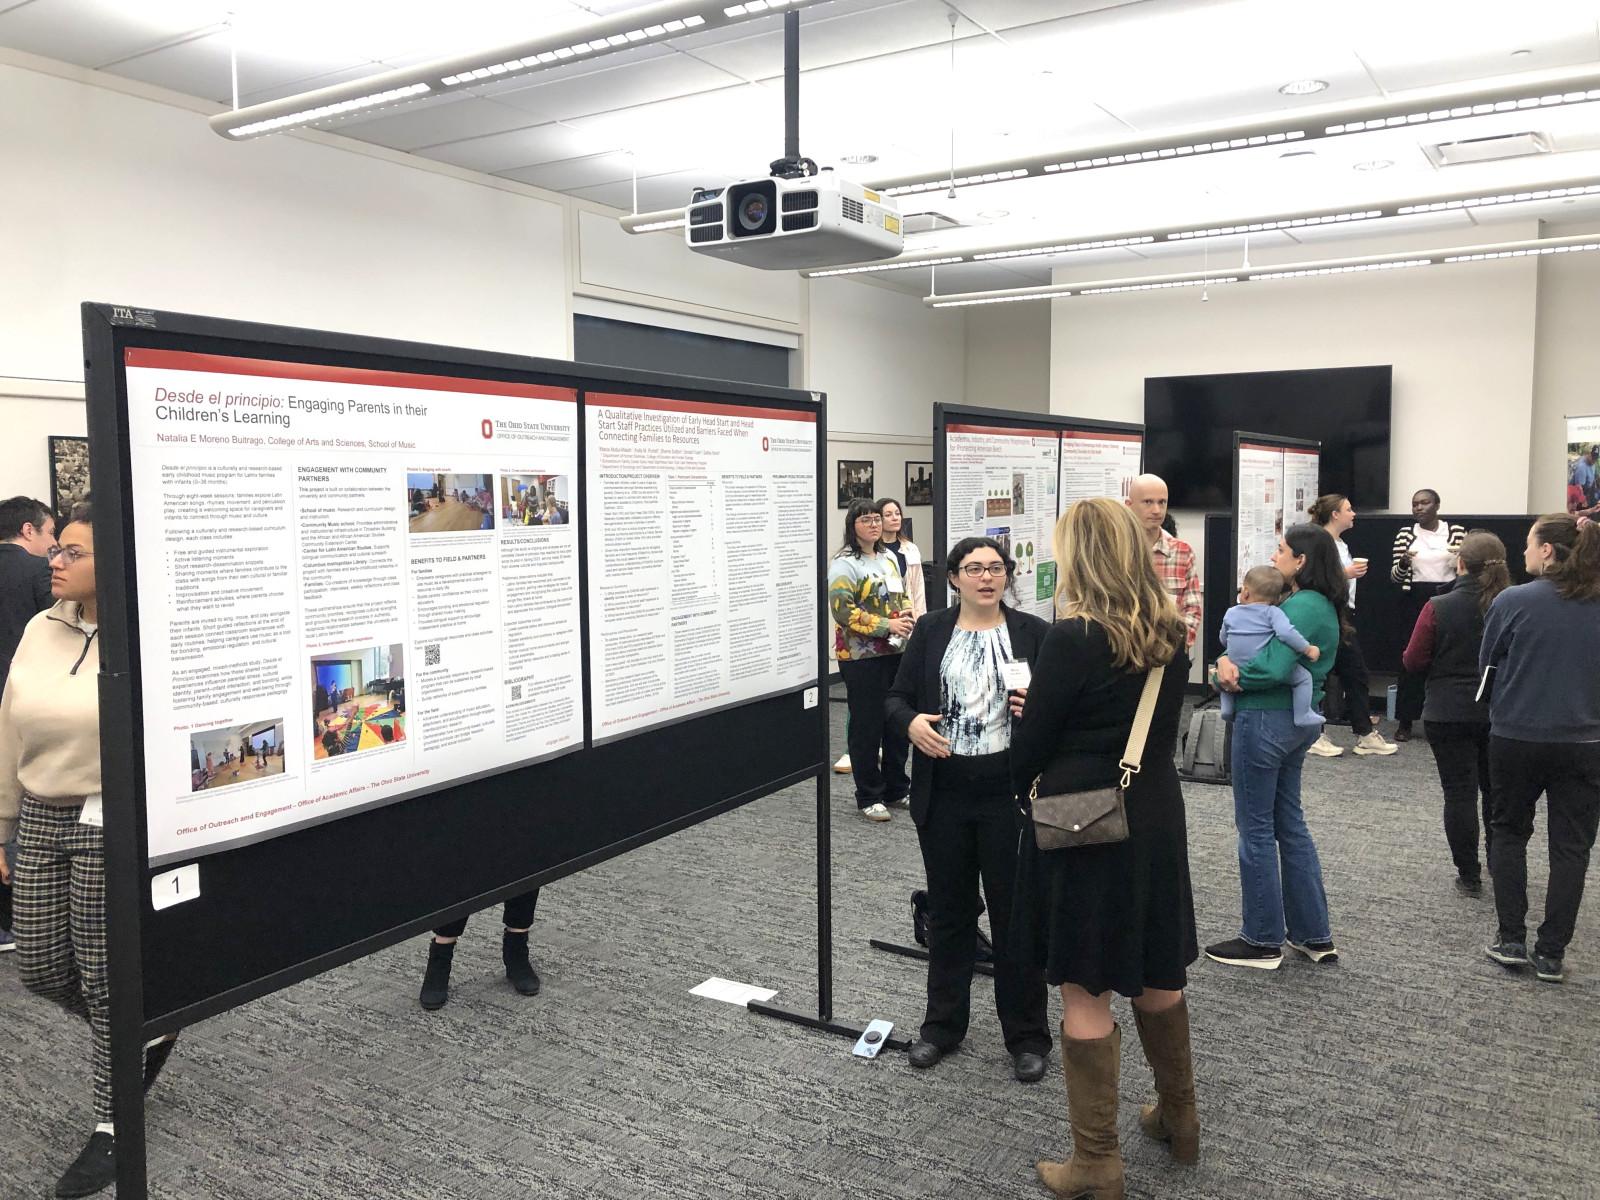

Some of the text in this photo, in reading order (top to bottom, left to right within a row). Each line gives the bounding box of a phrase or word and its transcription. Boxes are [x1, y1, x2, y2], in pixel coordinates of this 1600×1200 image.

[112, 307, 134, 320] ITA
[154, 387, 428, 416] Desde el principio: Engaging Parents in their
[233, 409, 290, 428] Learning
[597, 409, 604, 421] A
[604, 409, 643, 423] Qualitative
[643, 411, 681, 425] Investigation
[681, 414, 687, 424] of
[688, 415, 702, 427] Early
[702, 417, 716, 426] Head
[716, 417, 729, 427] Start
[730, 419, 740, 428] and
[598, 419, 616, 430] Start
[617, 420, 633, 431] Staff
[634, 422, 662, 432] Practices
[663, 423, 685, 434] Utilized
[685, 426, 696, 435] and
[717, 427, 733, 437] Faced
[733, 428, 749, 437] When
[156, 433, 188, 443] Natalia
[190, 434, 197, 443] E
[199, 434, 230, 444] Moreno
[267, 436, 296, 447] College
[296, 437, 304, 446] of
[305, 438, 320, 446] Arts
[321, 439, 334, 447] and
[335, 438, 366, 448] Sciences,
[368, 439, 390, 448] School
[390, 440, 397, 448] of
[398, 440, 416, 449] Music
[598, 430, 700, 445] Connecting Families to Resources
[809, 692, 814, 703] 2
[176, 827, 198, 836] Office
[199, 823, 207, 831] of
[208, 817, 239, 829] Outreach
[240, 813, 254, 822] and
[255, 804, 292, 818] Engagement
[297, 799, 315, 807] Office
[321, 790, 348, 801] Academic
[172, 875, 179, 894] 1
